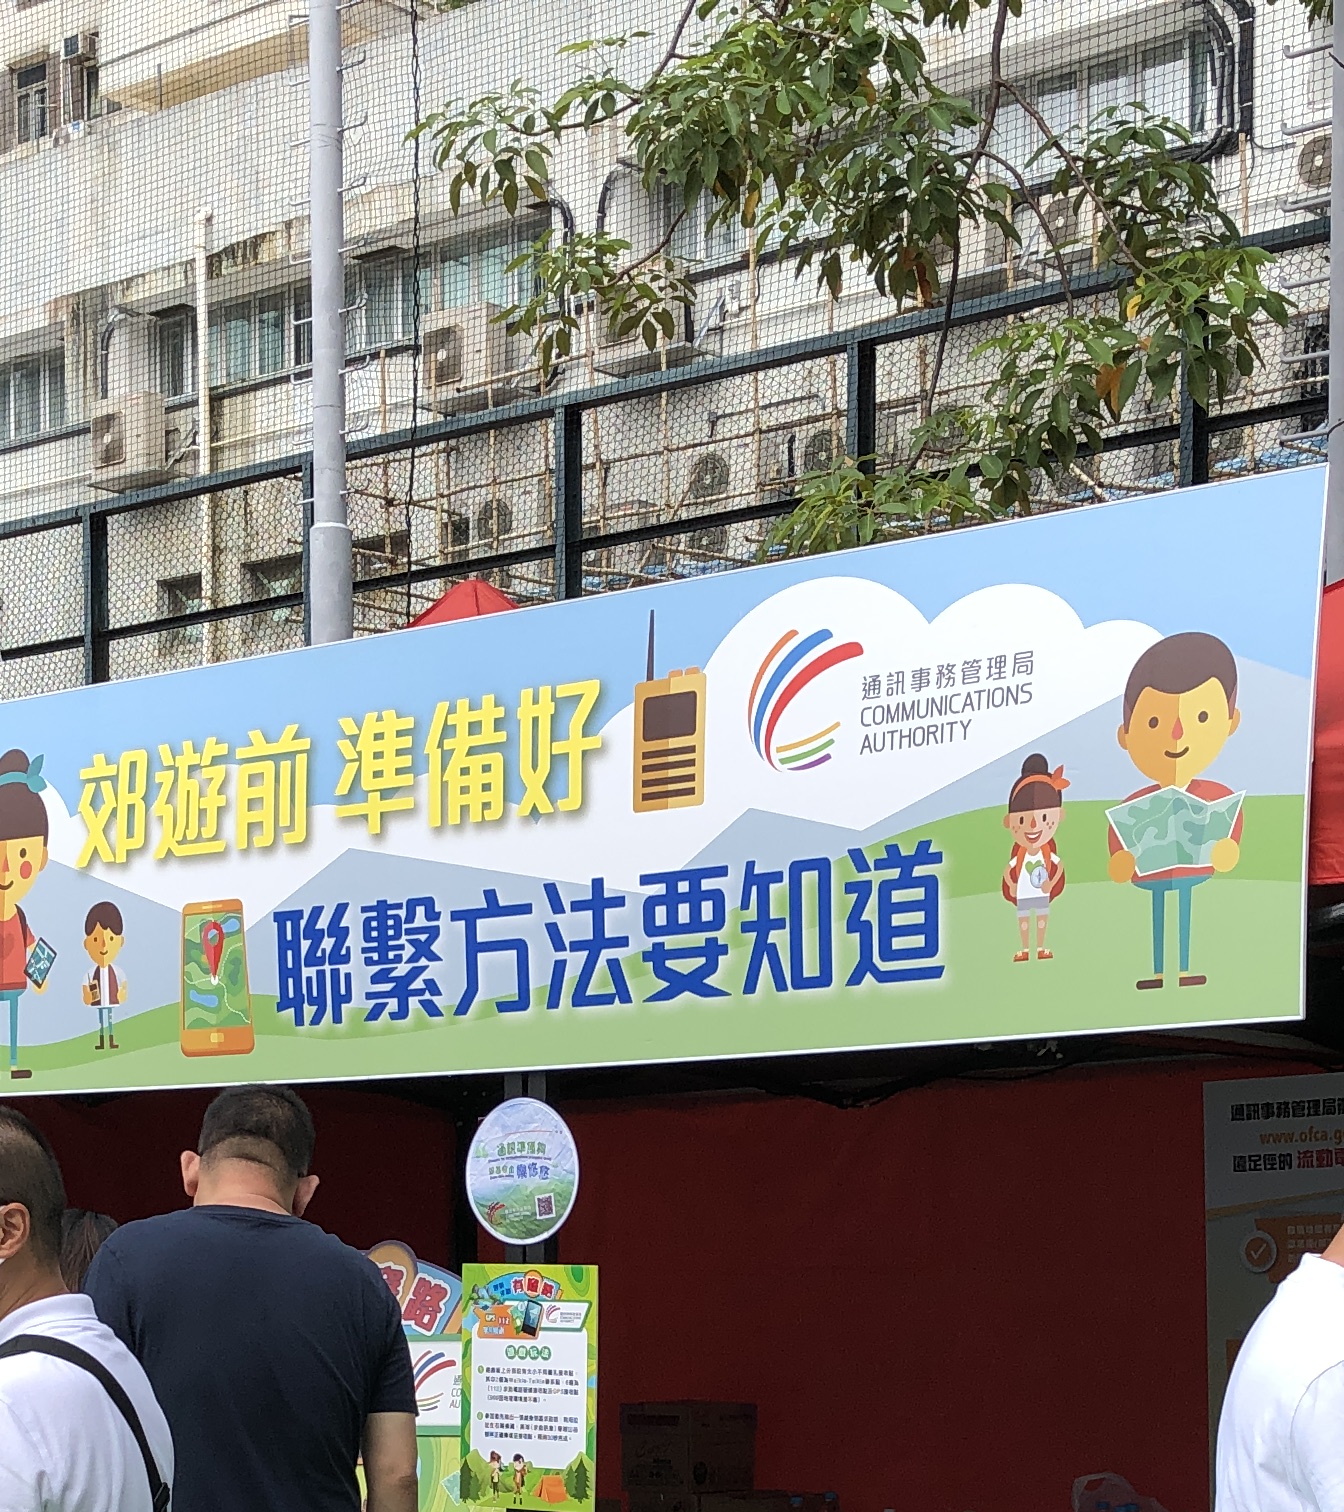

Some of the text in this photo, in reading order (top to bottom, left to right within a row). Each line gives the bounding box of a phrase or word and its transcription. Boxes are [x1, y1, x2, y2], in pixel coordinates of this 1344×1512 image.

[860, 651, 1035, 701] 通訊事務管理局
[859, 682, 1034, 728] COMMUNICATIONS
[859, 719, 974, 759] AUTHORITY
[76, 678, 604, 868] 郊遊前 準備好
[274, 839, 946, 1029] 聯繫方法要知道
